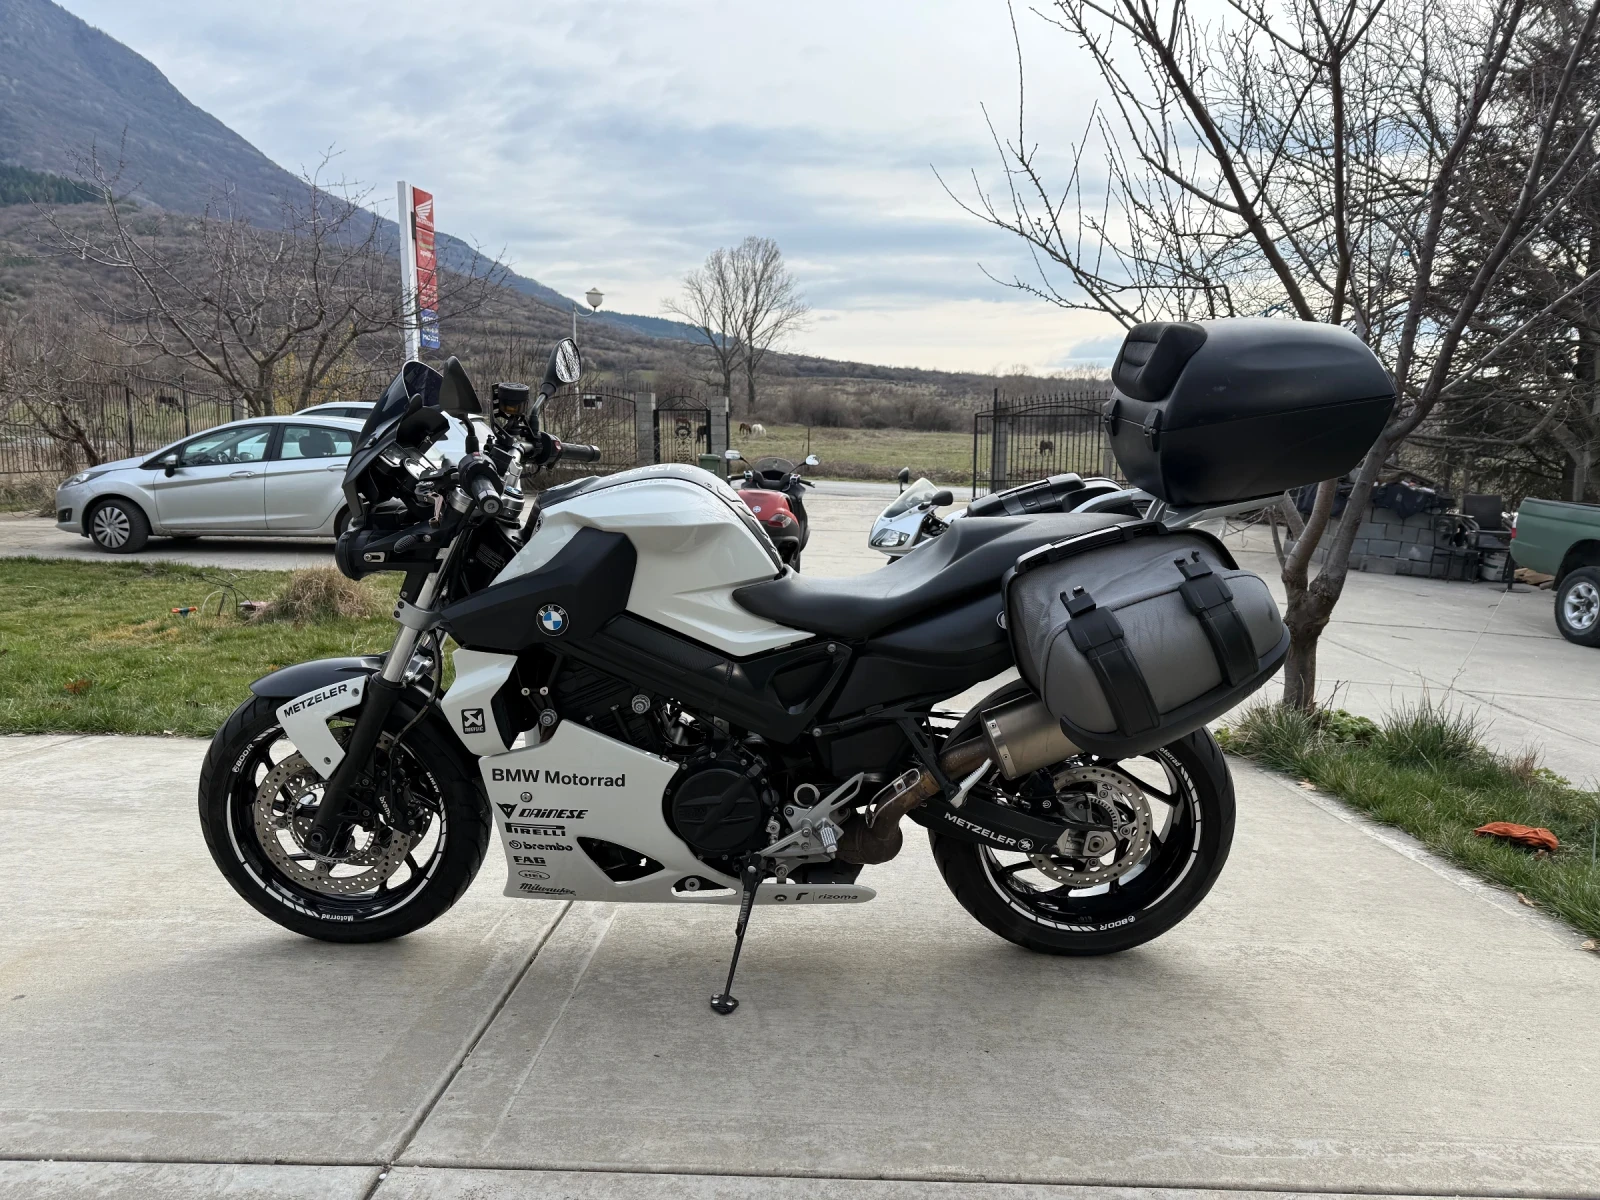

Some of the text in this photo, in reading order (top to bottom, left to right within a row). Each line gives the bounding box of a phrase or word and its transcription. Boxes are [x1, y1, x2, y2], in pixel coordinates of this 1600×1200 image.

[283, 684, 348, 718] METZELER
[491, 768, 626, 788] BMW Motorrad
[504, 822, 566, 837] PIRELLI
[944, 812, 1017, 846] METZELER
[522, 841, 574, 851] brembo
[513, 855, 546, 865] FAG
[818, 892, 859, 900] rizoma
[320, 913, 354, 922] Motorrad
